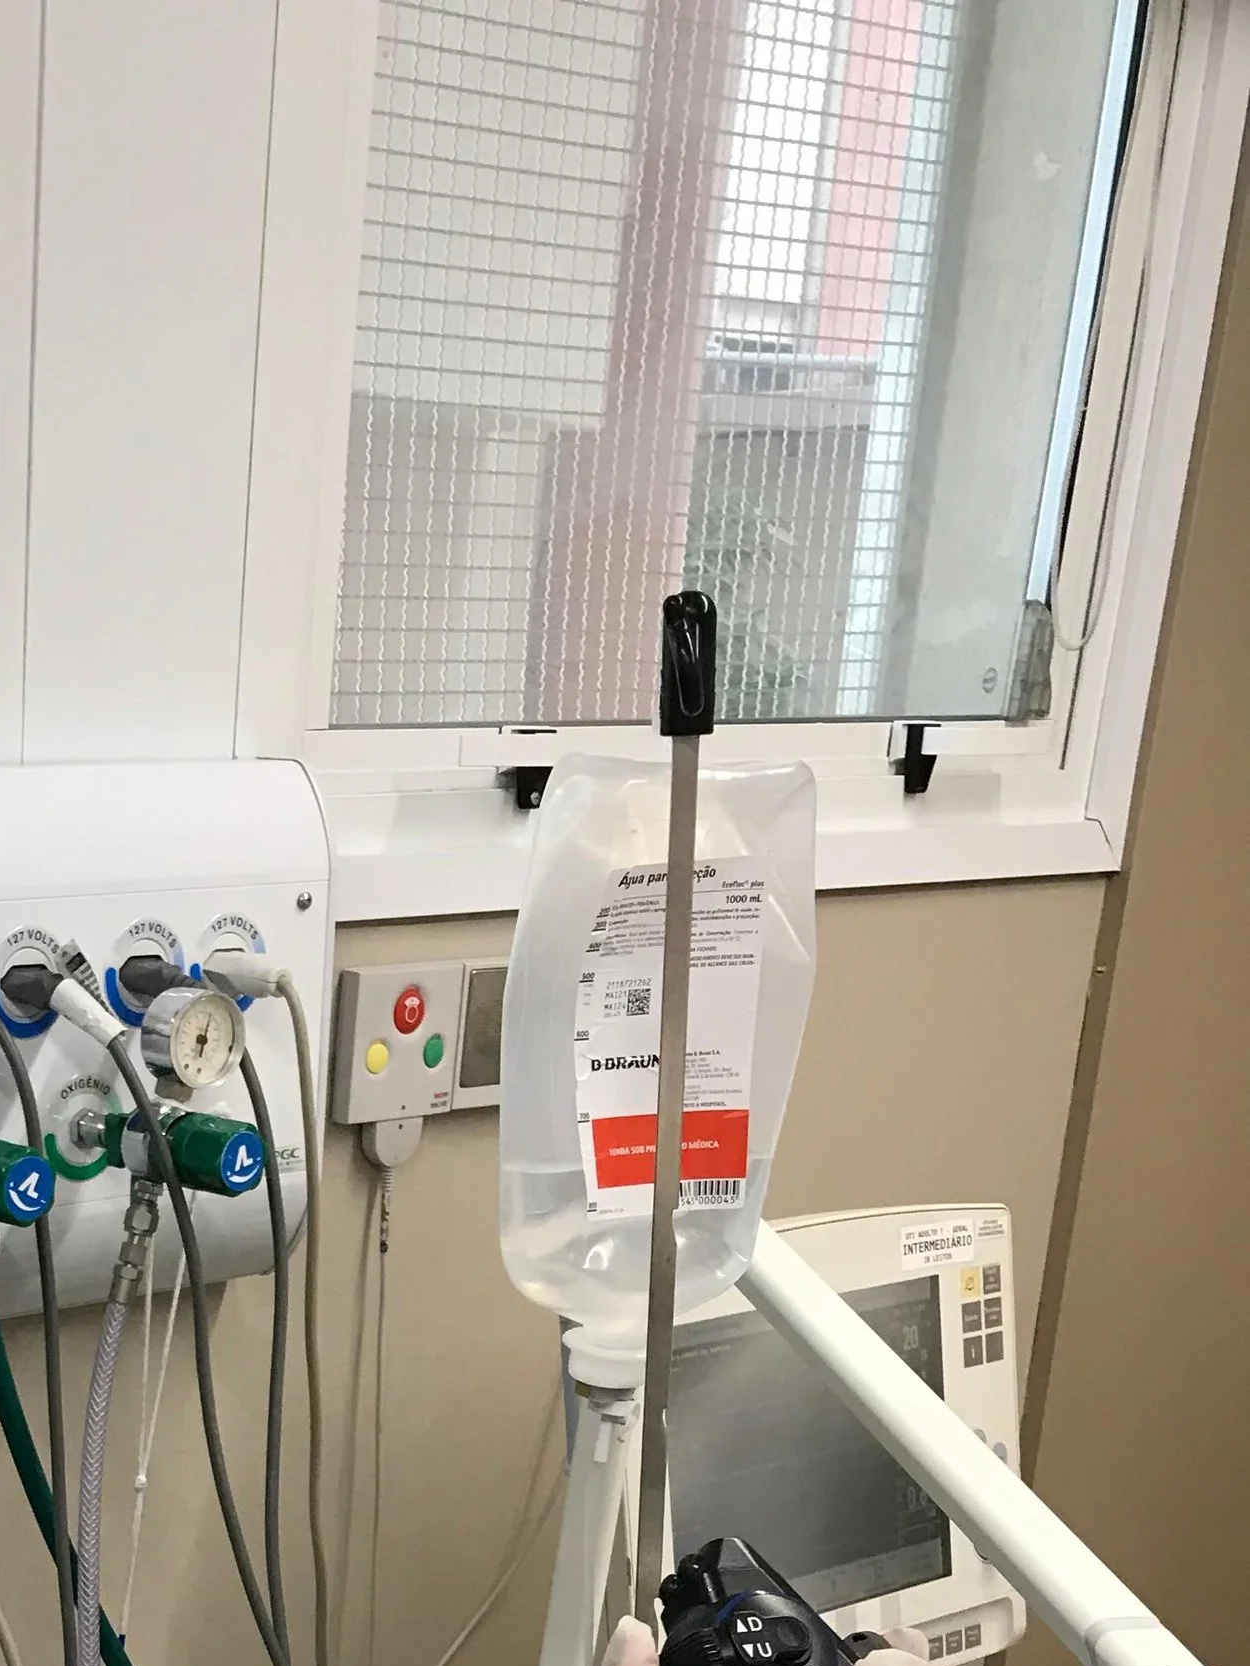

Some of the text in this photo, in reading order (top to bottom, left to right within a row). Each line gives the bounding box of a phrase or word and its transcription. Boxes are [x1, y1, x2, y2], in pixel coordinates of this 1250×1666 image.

[647, 873, 668, 887] par
[725, 894, 763, 904] 1000 mL
[129, 921, 178, 949] 127 VOLTS
[211, 915, 259, 940] 127 VOLTS
[7, 928, 60, 954] 127 VOLTS
[61, 1075, 110, 1099] OXIGÊNIO
[747, 1616, 763, 1632] D
[756, 1642, 772, 1658] U
